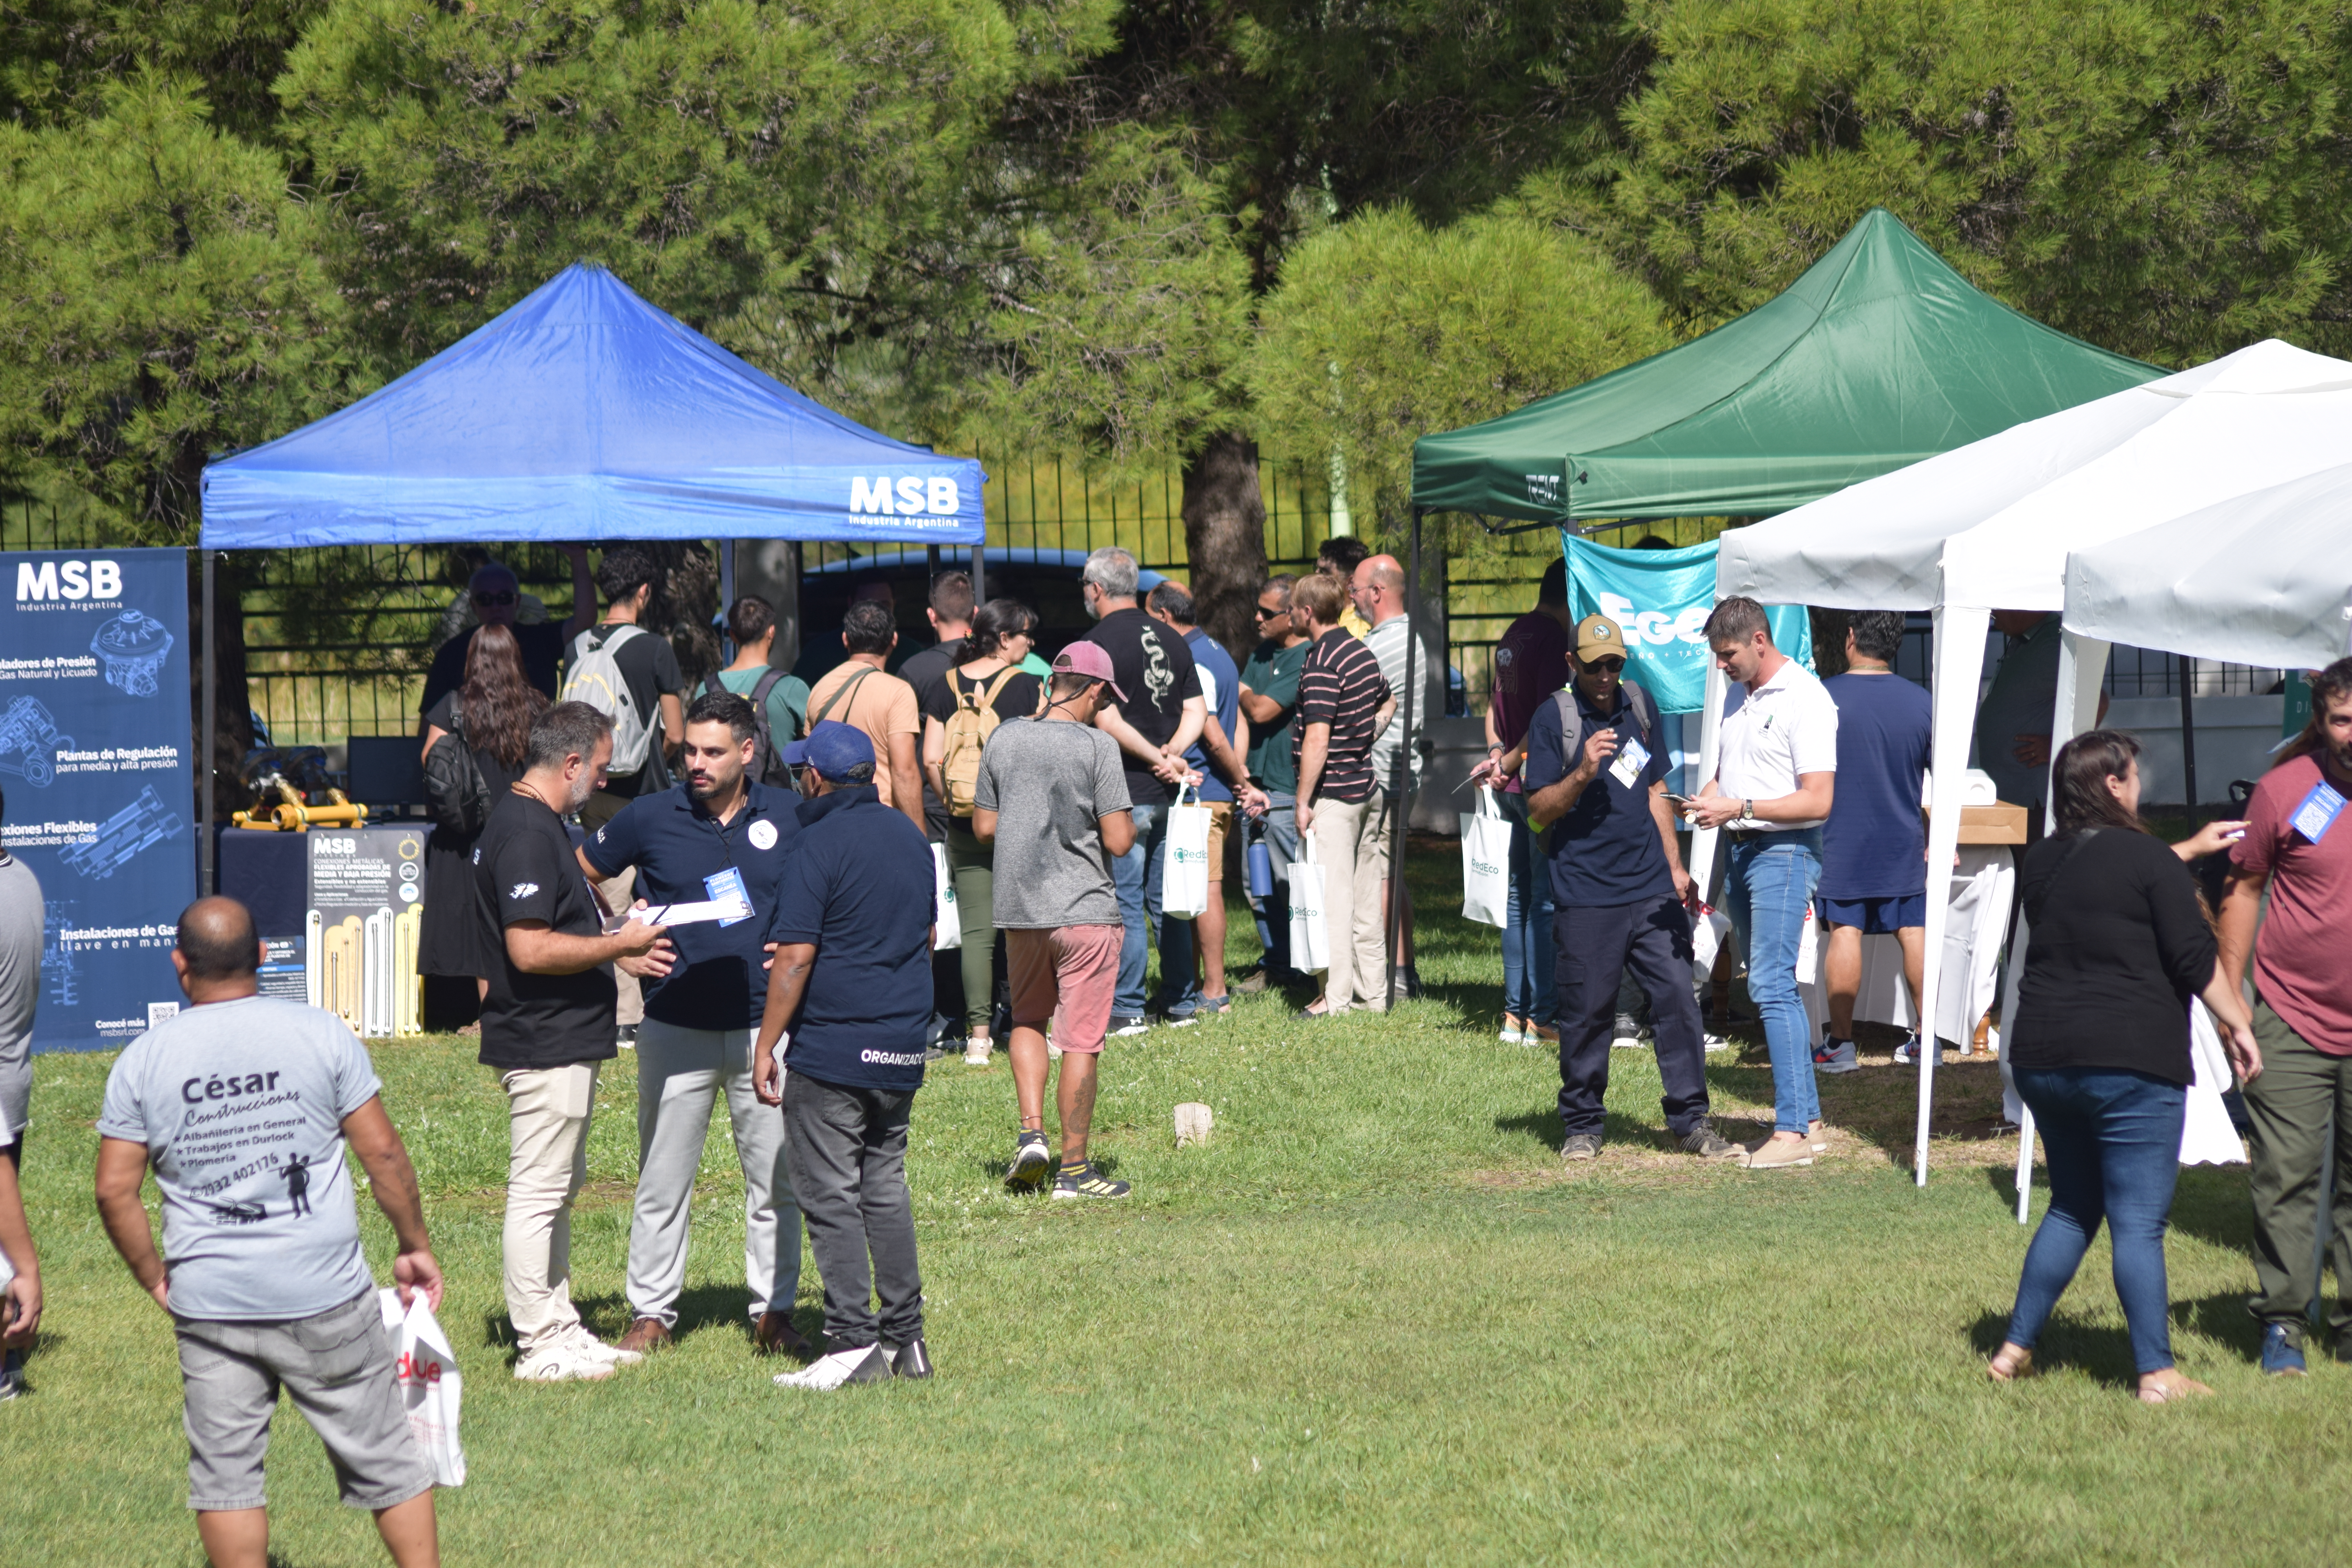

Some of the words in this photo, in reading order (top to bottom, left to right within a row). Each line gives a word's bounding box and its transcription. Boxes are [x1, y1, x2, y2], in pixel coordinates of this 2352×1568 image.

[850, 477, 959, 515] MSB
[849, 515, 899, 526] Industria
[904, 516, 959, 528] Argentina
[16, 560, 122, 601] MSB
[16, 602, 65, 612] Industria
[70, 601, 122, 612] Argentina
[42, 657, 55, 668] de
[56, 655, 96, 668] Presión
[0, 670, 16, 680] Gas
[18, 668, 52, 679] Natural
[53, 670, 60, 680] y
[61, 667, 97, 677] Licuado
[56, 749, 99, 761] Plantas
[100, 748, 115, 760] de
[117, 745, 177, 759] Regulación
[56, 763, 78, 774] para
[80, 760, 111, 771] media
[113, 762, 118, 772] y
[120, 759, 140, 769] alta
[142, 758, 178, 770] presión
[44, 820, 97, 834] Flexibles
[1, 834, 62, 847] nstalaciones
[63, 833, 76, 844] de
[78, 833, 97, 843] Gas
[314, 838, 356, 854] MSB
[1472, 858, 1499, 874] RedEco
[1472, 869, 1488, 877] ermofusión
[361, 869, 391, 878] PRESIÓN
[710, 872, 733, 883] PLOMEROS
[711, 875, 734, 886] SANITARISTAS
[714, 883, 737, 894] ESCANÉA
[60, 927, 138, 940] Instalaciones
[140, 924, 156, 936] de
[61, 940, 102, 951] llave
[112, 940, 130, 949] en
[95, 1018, 126, 1029] Conocé
[127, 1017, 146, 1027] más
[181, 1071, 280, 1105] César
[185, 1091, 300, 1126] Construcciones
[247, 1124, 260, 1133] en
[263, 1116, 306, 1130] General
[185, 1142, 232, 1156] Trabajos
[236, 1138, 249, 1148] en
[252, 1131, 295, 1144] Durlock
[201, 1176, 231, 1198] 2932
[232, 1152, 279, 1181] 402176
